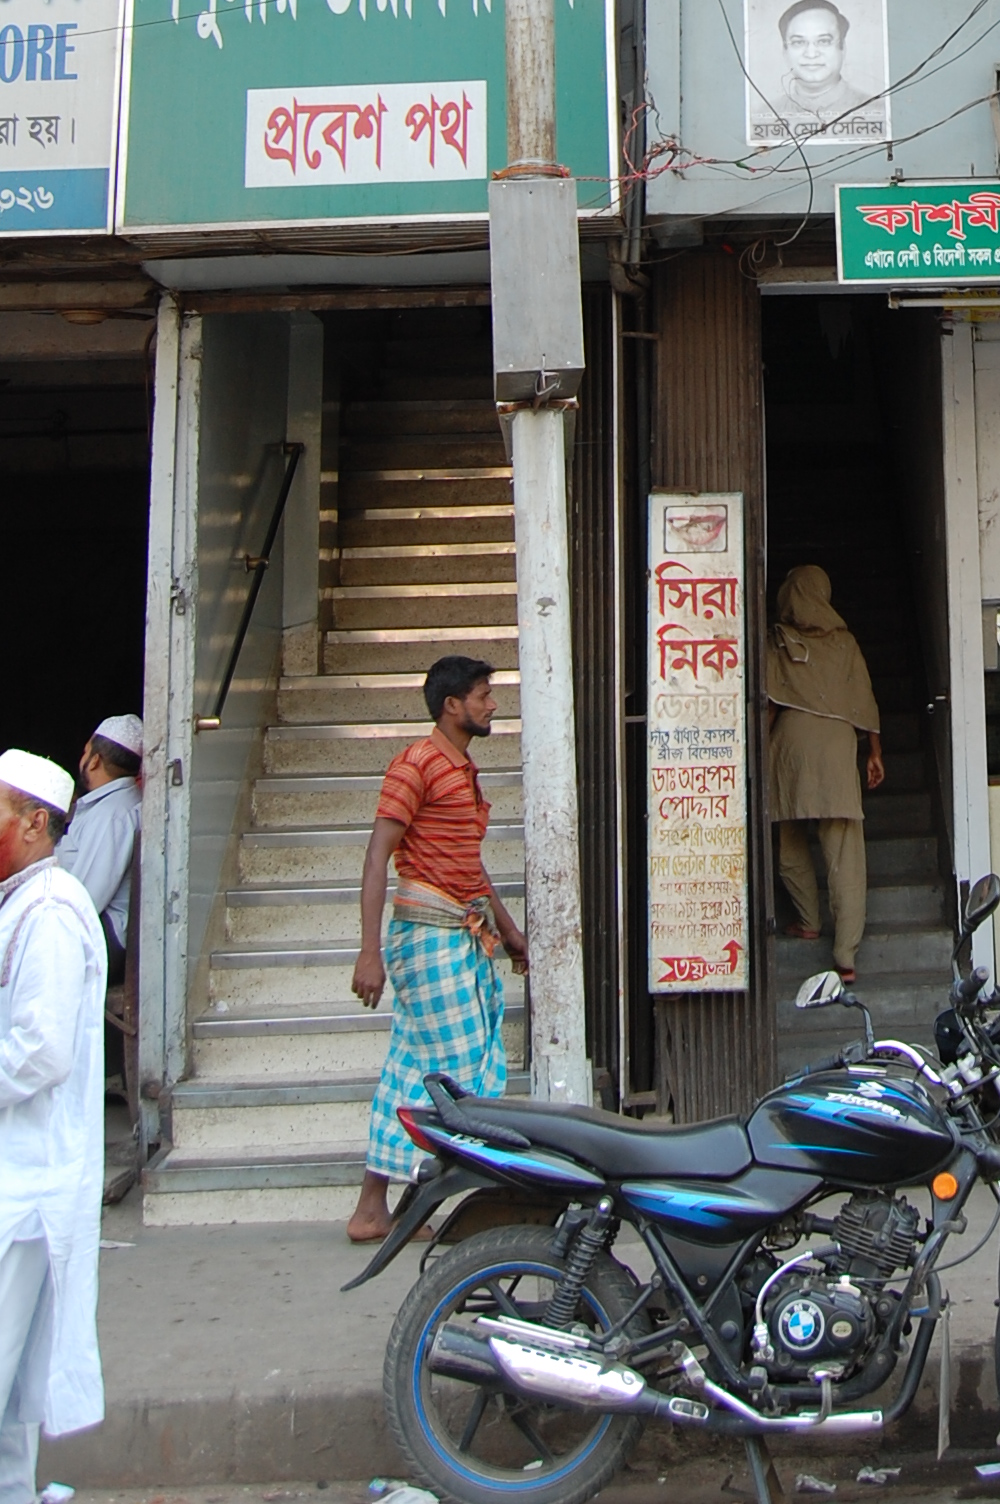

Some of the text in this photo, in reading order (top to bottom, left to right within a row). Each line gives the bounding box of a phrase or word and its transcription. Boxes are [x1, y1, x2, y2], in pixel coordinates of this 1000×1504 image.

[265, 89, 474, 176] প্রবেশ পথ
[753, 117, 882, 138] হাজী সেলিম
[865, 250, 895, 268] এখানে
[897, 244, 920, 268] দেশী
[923, 250, 931, 265] ও
[933, 243, 965, 266] বিদেশী
[968, 248, 992, 266] সকল
[652, 765, 736, 793] ডাঃ অনুপম
[659, 795, 729, 819] পোদ্দার
